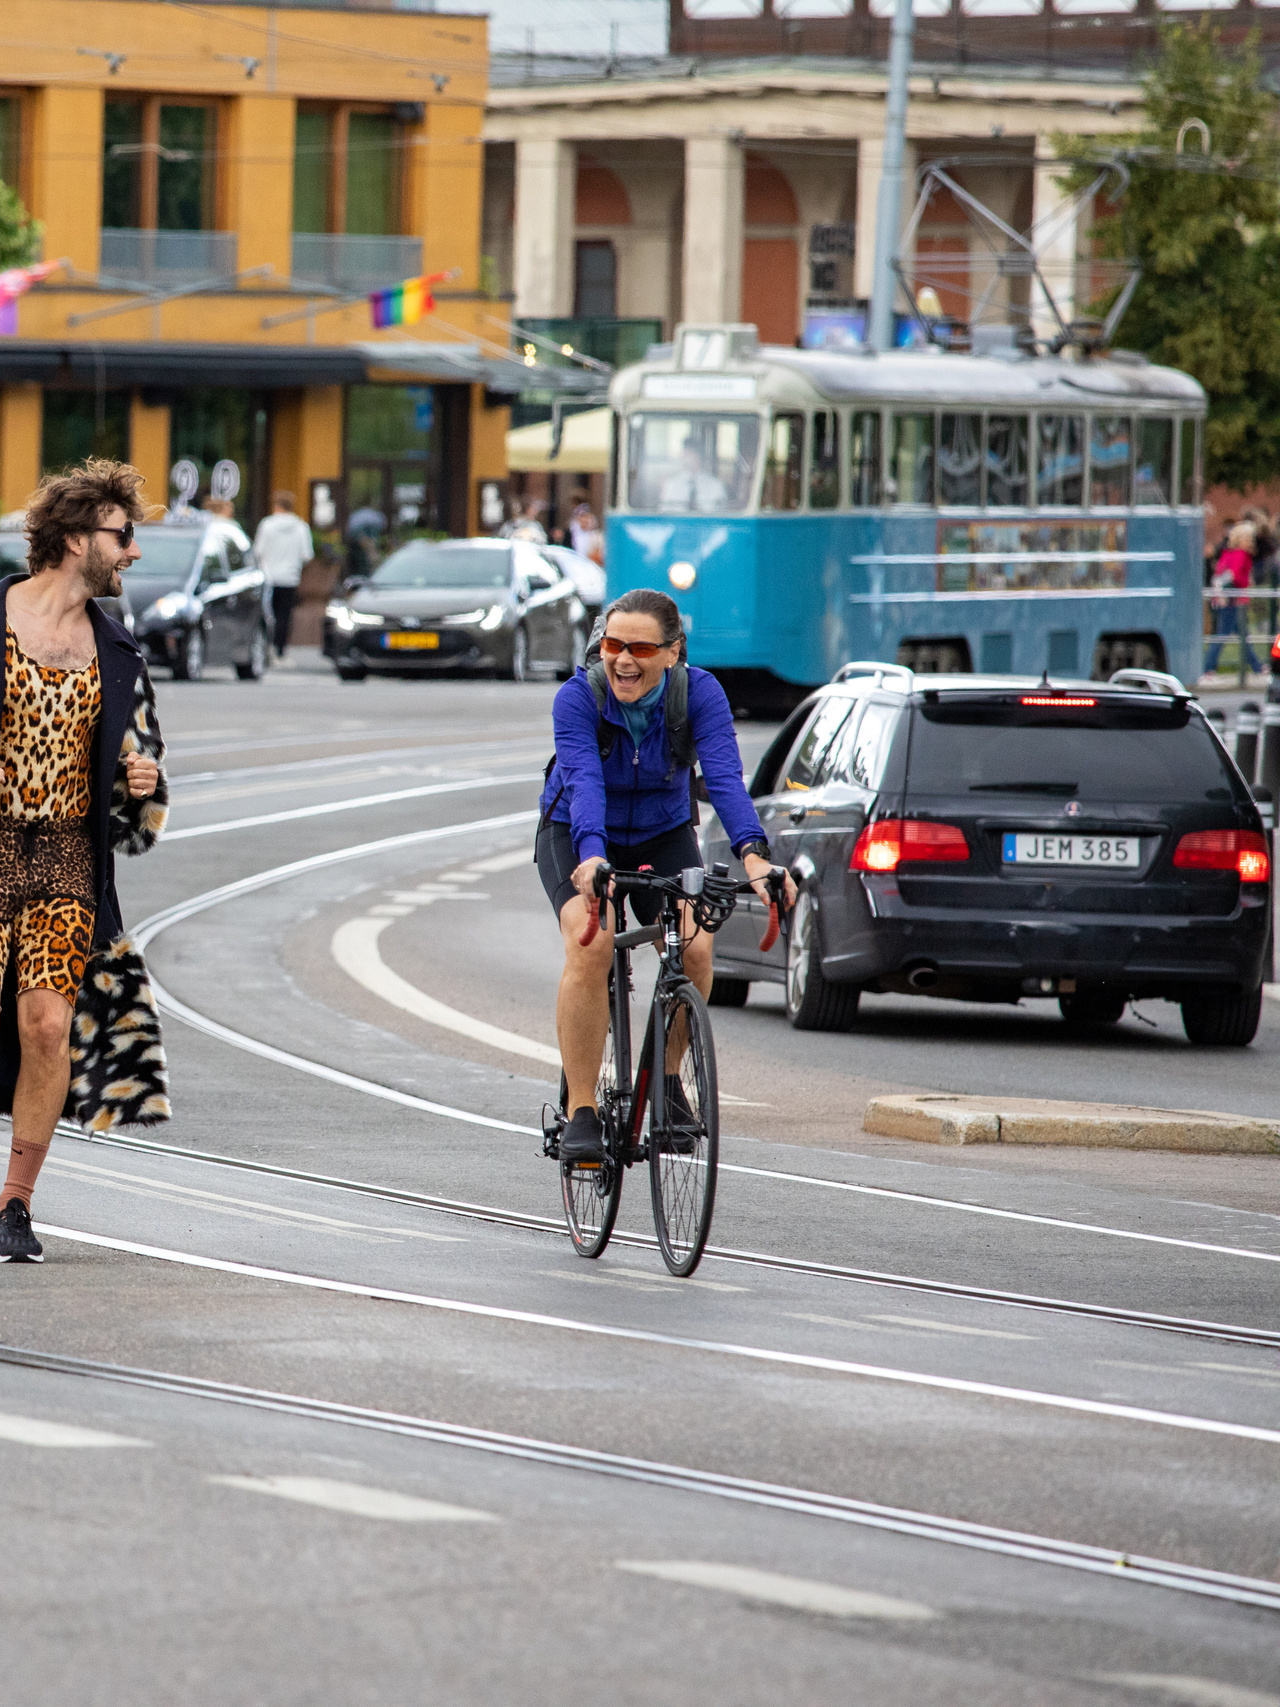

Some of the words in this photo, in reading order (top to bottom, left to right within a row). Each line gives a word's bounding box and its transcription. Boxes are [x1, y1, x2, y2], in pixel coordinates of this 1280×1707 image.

[696, 330, 713, 367] 7
[1025, 836, 1073, 860] JEM
[1080, 839, 1129, 861] 385
